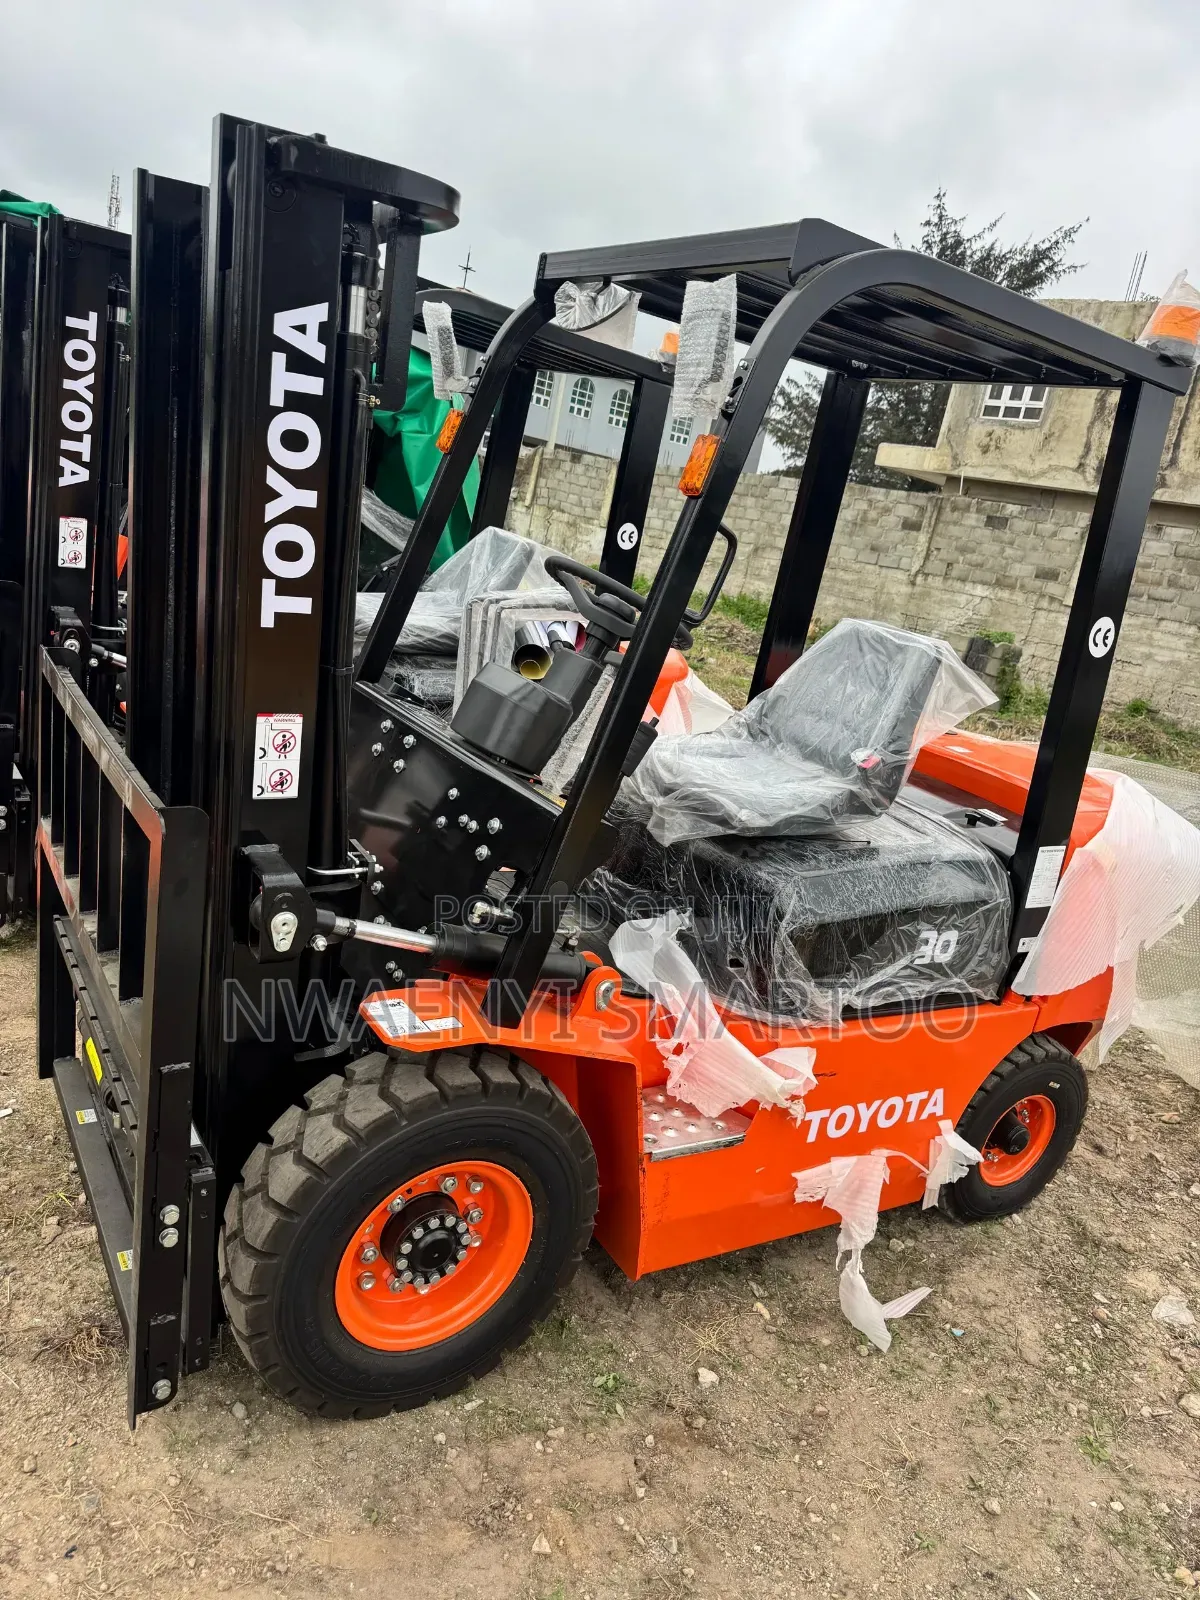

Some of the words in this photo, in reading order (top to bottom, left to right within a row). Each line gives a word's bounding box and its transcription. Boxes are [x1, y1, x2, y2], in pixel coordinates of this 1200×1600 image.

[58, 311, 98, 488] TOYOTA
[260, 301, 329, 628] TOYOTA
[913, 930, 959, 965] 30
[804, 1088, 944, 1144] TOYOTA
